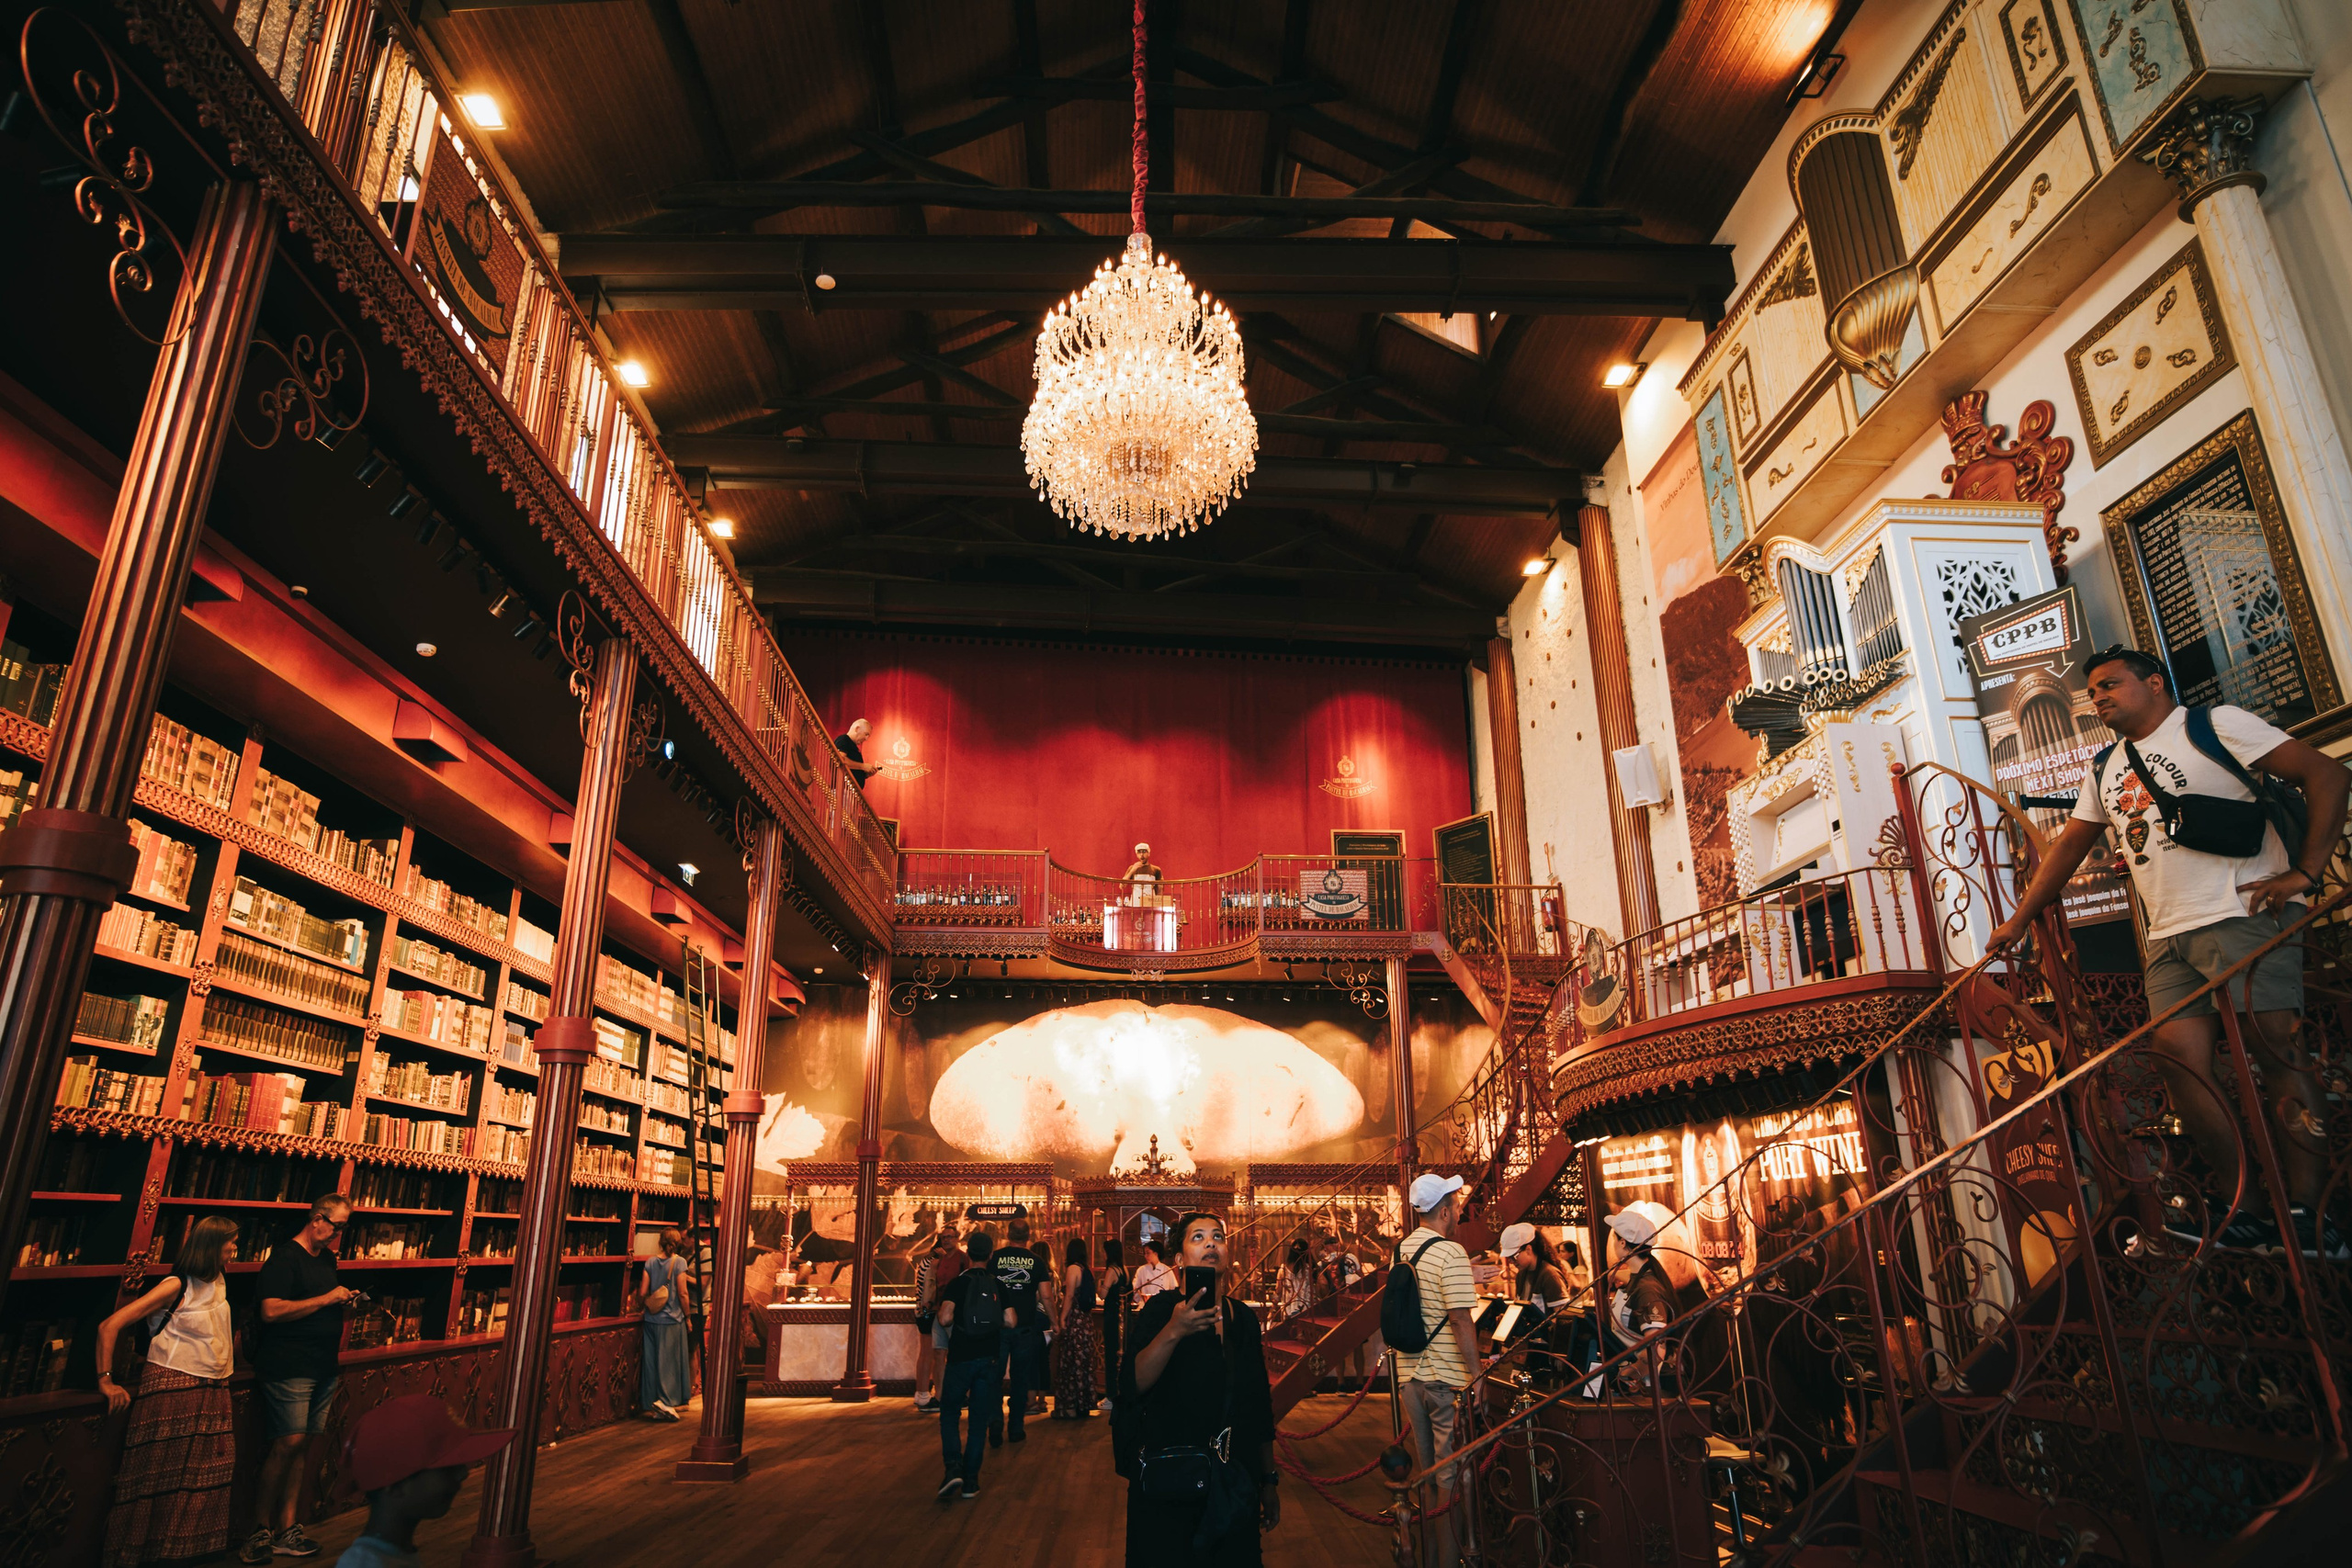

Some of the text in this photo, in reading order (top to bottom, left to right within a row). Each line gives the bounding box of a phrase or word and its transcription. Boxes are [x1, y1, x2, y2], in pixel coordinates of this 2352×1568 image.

[434, 231, 458, 281] PASTEL
[1991, 617, 2057, 649] CPPB
[1981, 672, 2017, 692] APRESENTA:
[1996, 758, 2043, 782] PRÓXIMO
[2026, 765, 2088, 793] NEXT SHOW
[2145, 753, 2188, 790] COLOUR
[1751, 1100, 1858, 1139] VINHO DO PORT
[1756, 1131, 1868, 1182] PORT WINE
[2006, 1144, 2035, 1175] CHEESY
[977, 1206, 1017, 1214] CHEESY SHEEP
[998, 1257, 1035, 1266] MISANO
